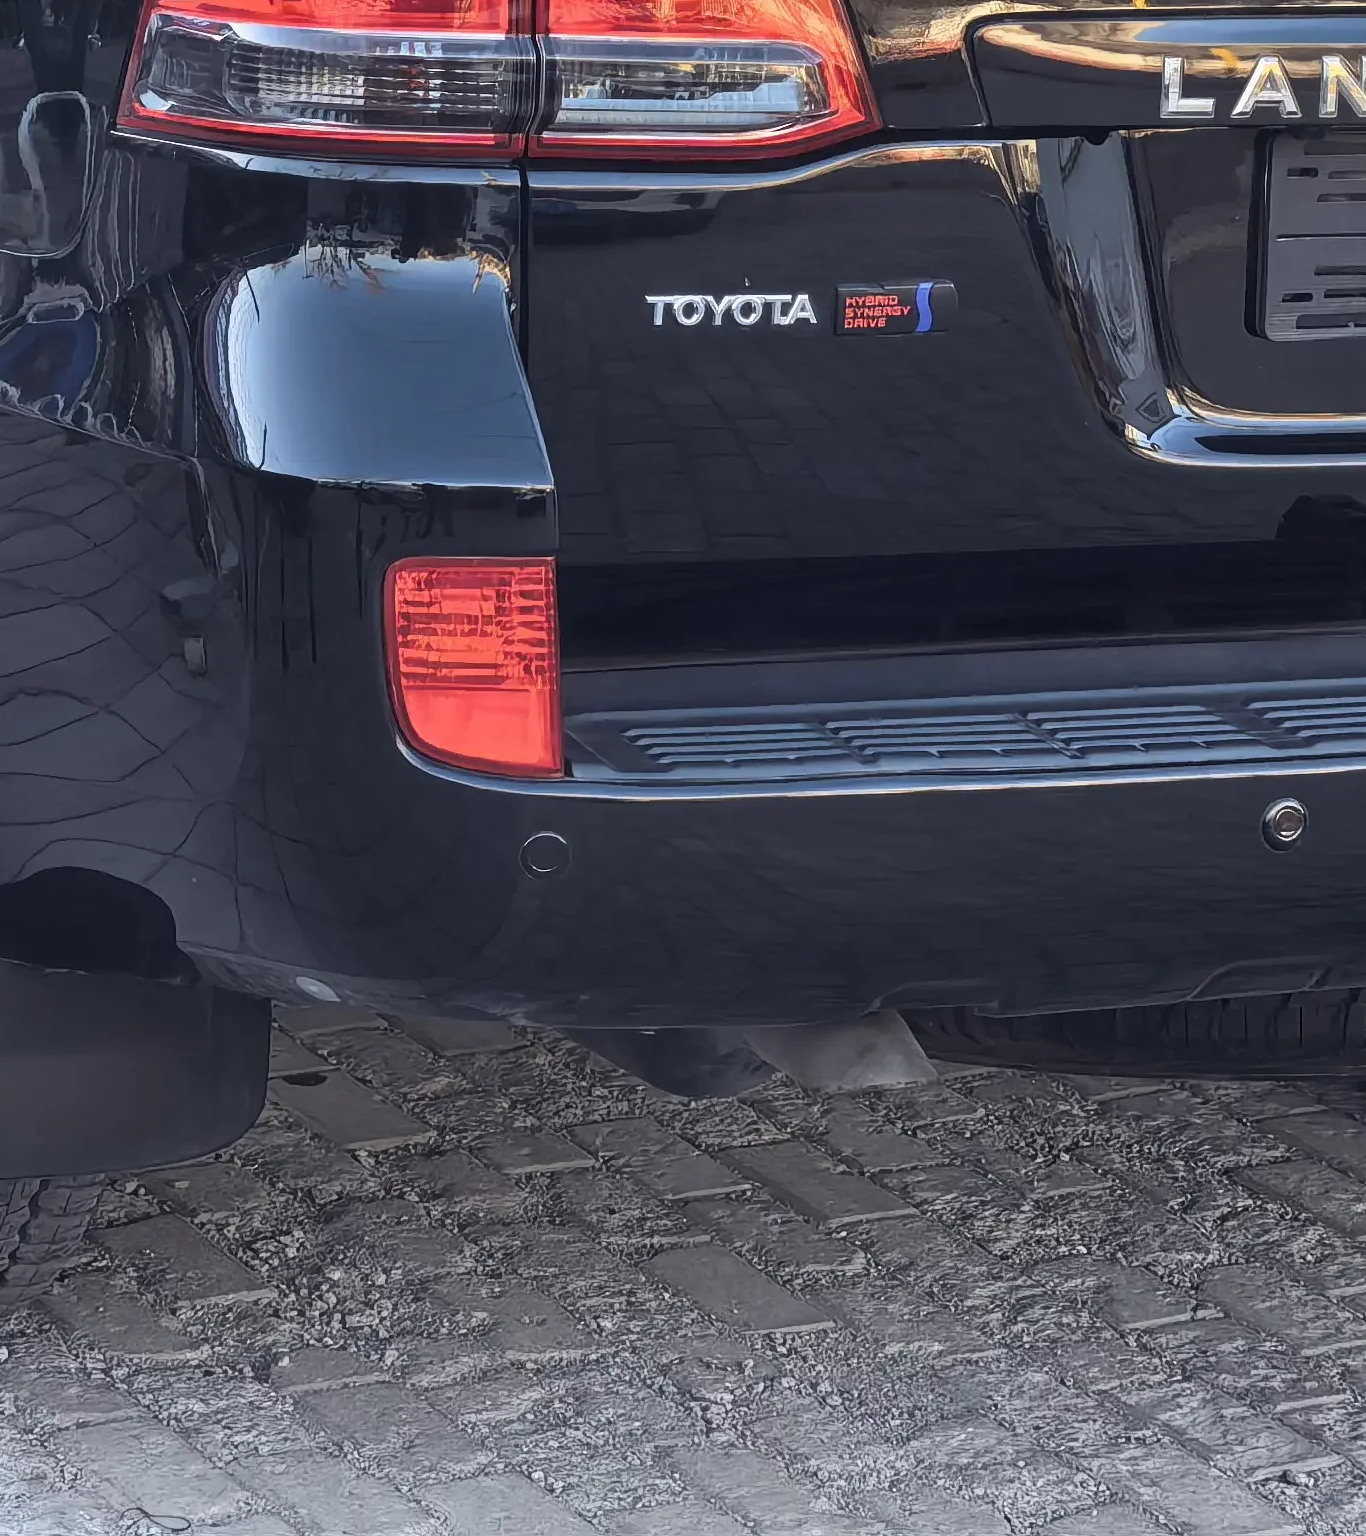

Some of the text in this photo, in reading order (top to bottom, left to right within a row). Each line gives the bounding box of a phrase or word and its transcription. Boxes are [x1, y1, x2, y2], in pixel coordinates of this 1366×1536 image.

[845, 295, 899, 307] HYBRID
[645, 294, 818, 327] TOYOTA
[845, 306, 911, 318] SYNERGY
[844, 317, 887, 329] DRIVE
